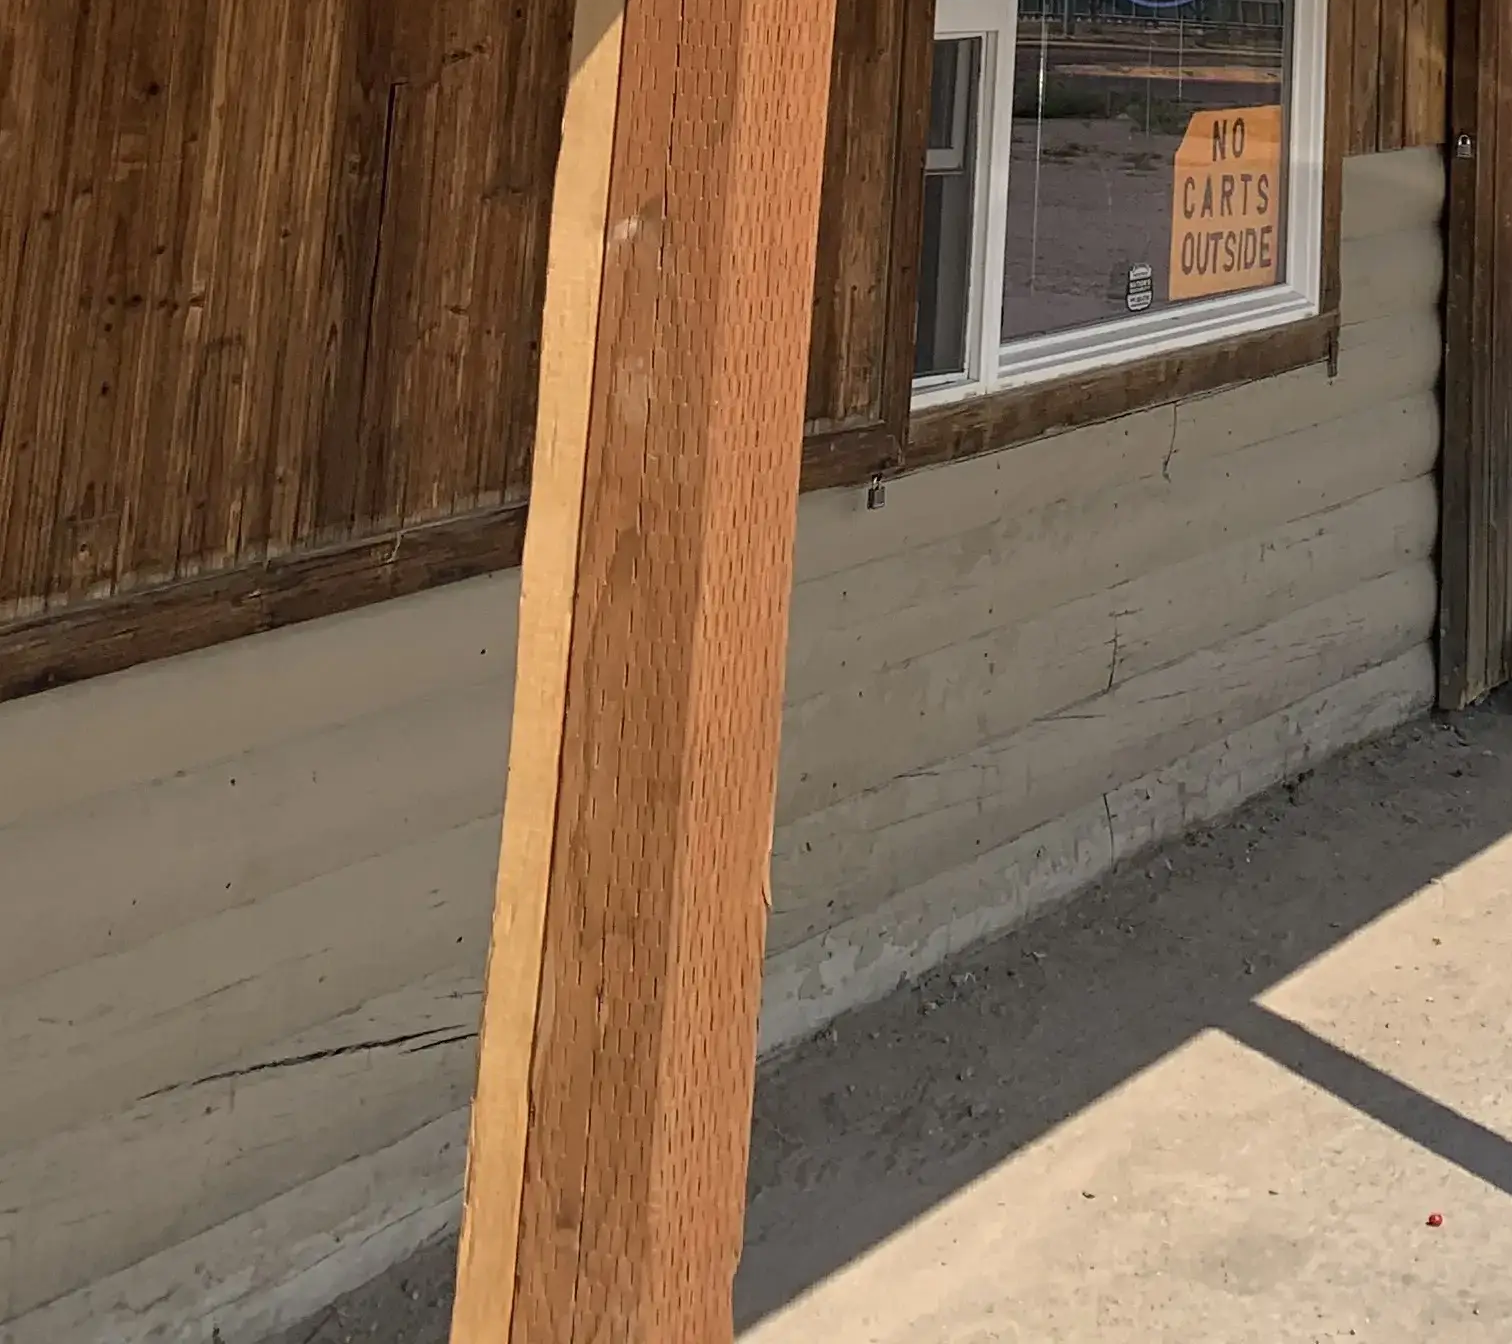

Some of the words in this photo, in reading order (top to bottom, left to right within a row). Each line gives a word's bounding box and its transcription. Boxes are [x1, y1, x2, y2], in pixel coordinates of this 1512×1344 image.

[1211, 117, 1245, 162] NO
[1182, 173, 1270, 220] CARTS
[1181, 225, 1273, 276] OUTSIDE
